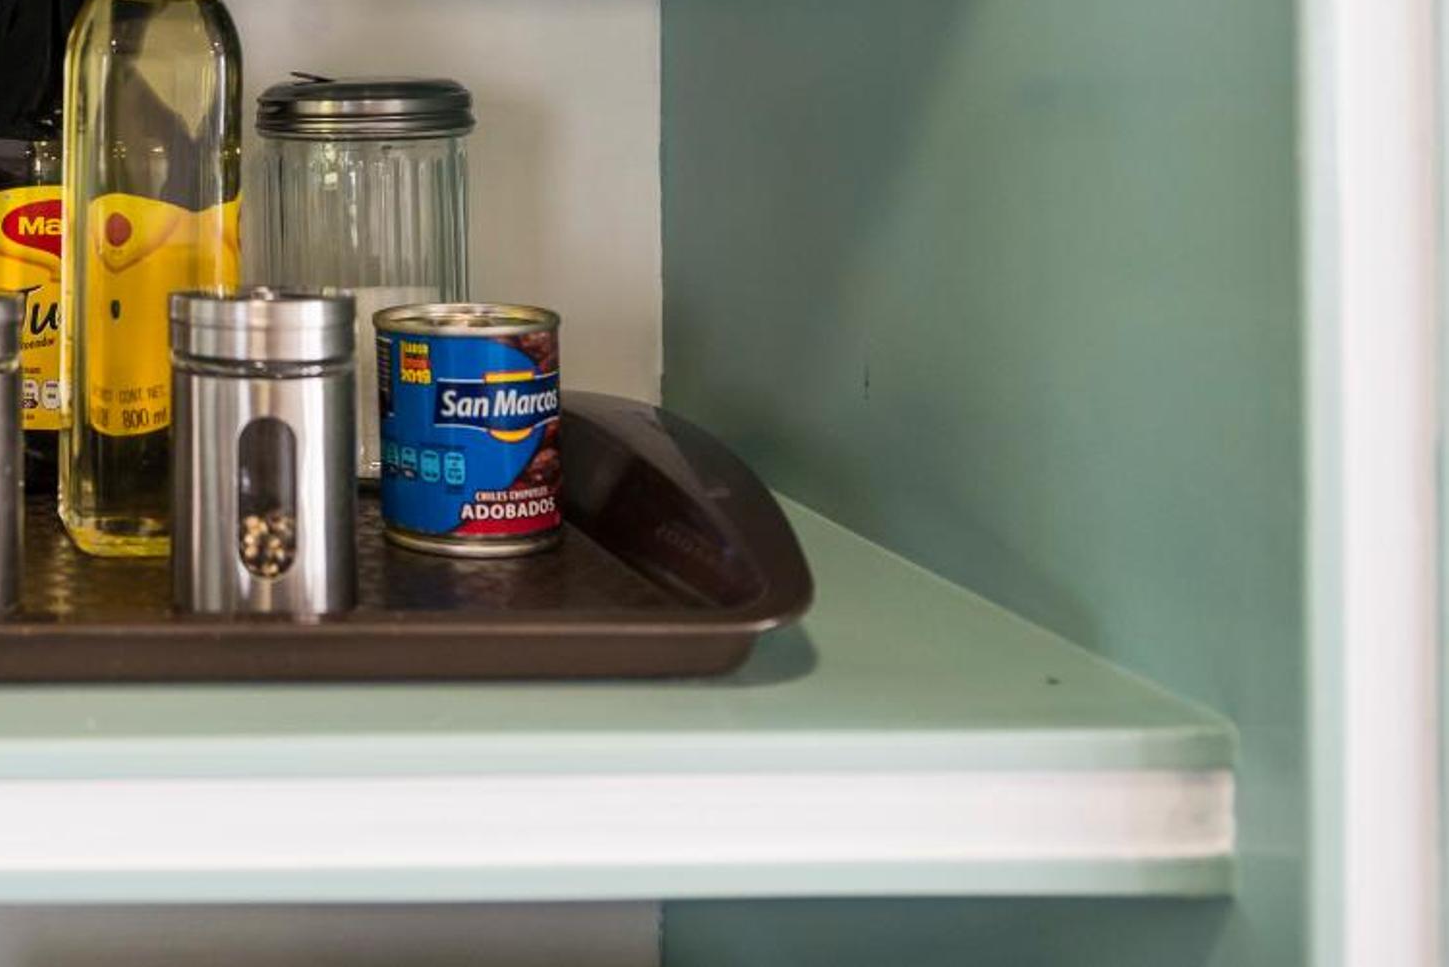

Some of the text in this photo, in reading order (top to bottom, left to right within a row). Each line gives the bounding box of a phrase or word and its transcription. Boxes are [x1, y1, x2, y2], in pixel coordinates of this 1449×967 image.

[18, 215, 62, 235] Ma
[441, 388, 558, 418] San Marcos
[461, 497, 555, 520] ADOBADOS
